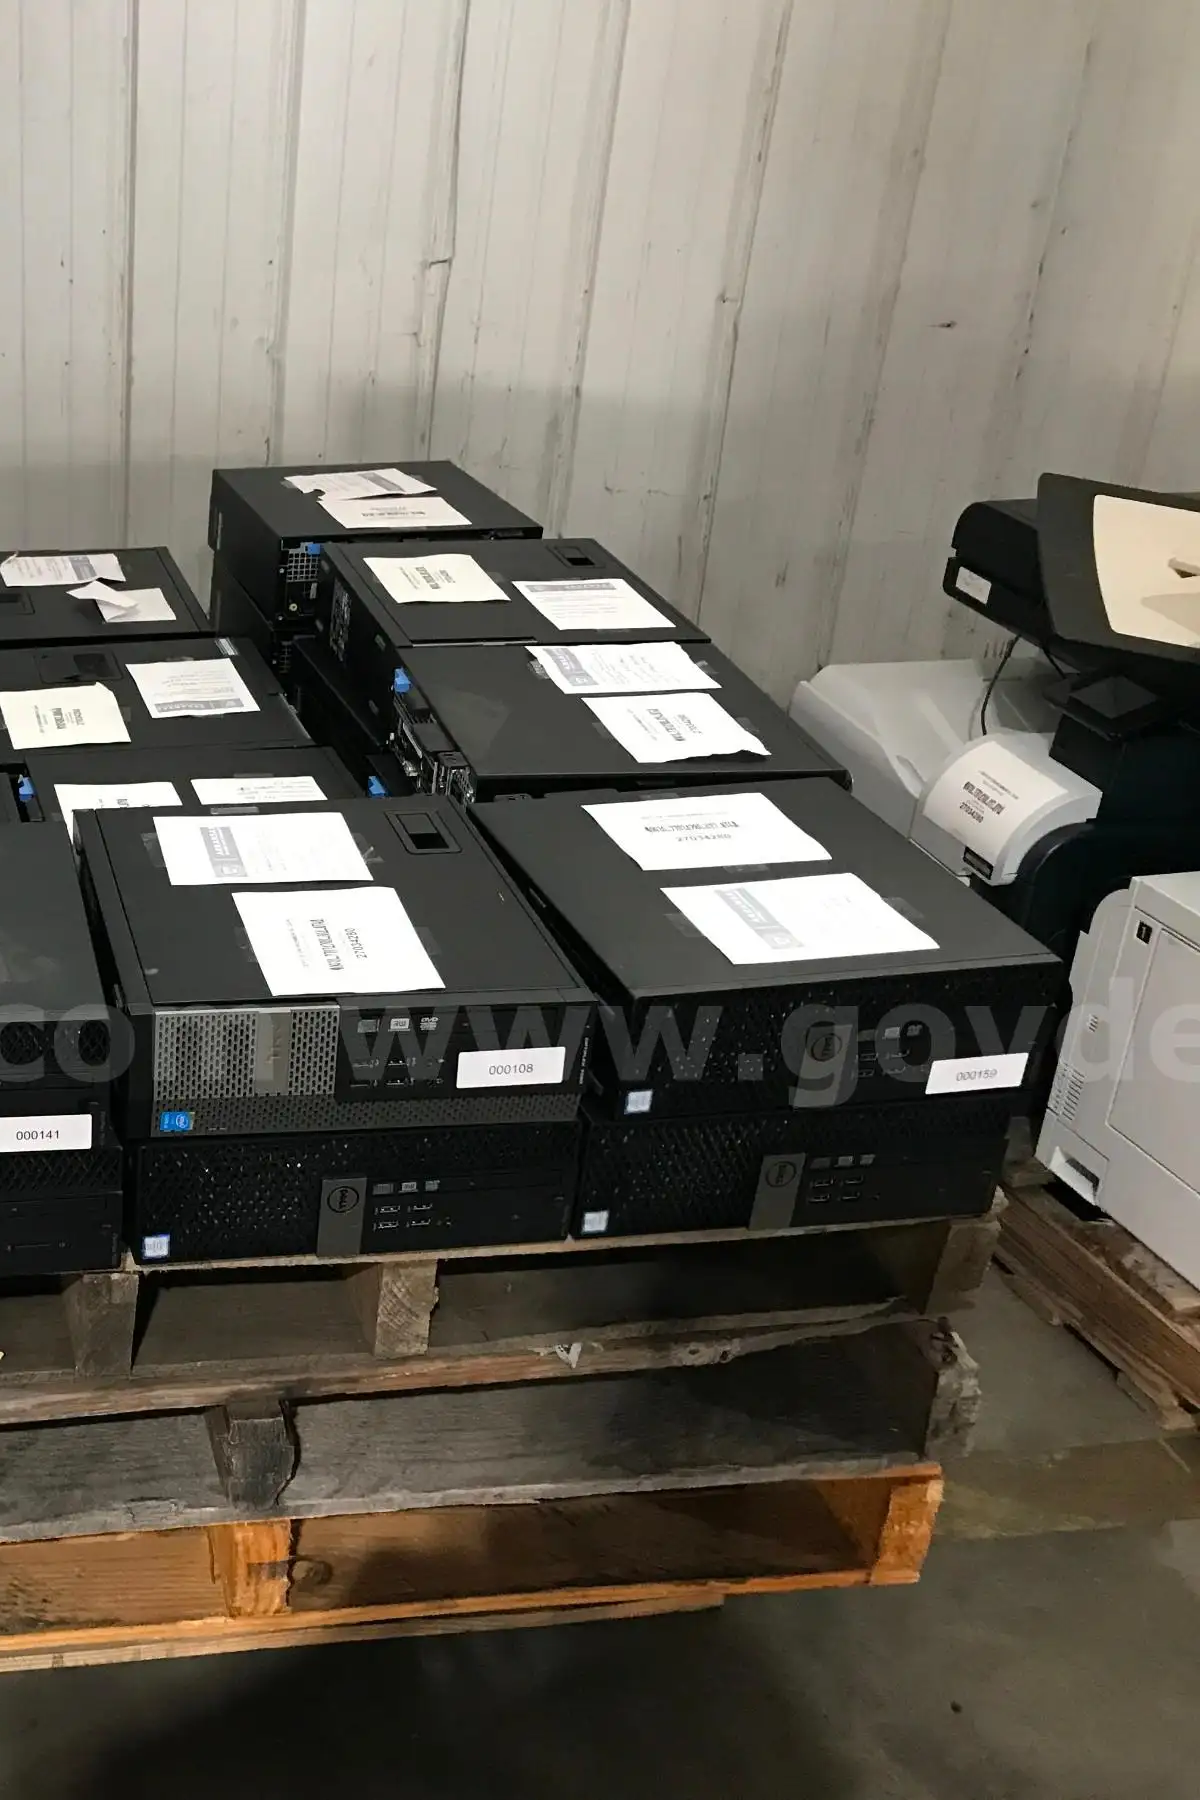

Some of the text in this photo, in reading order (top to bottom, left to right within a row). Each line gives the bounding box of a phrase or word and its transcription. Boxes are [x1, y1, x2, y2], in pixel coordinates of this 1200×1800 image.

[488, 1063, 534, 1075] 000108
[956, 1069, 998, 1082] 000159
[15, 1129, 60, 1141] 000141
